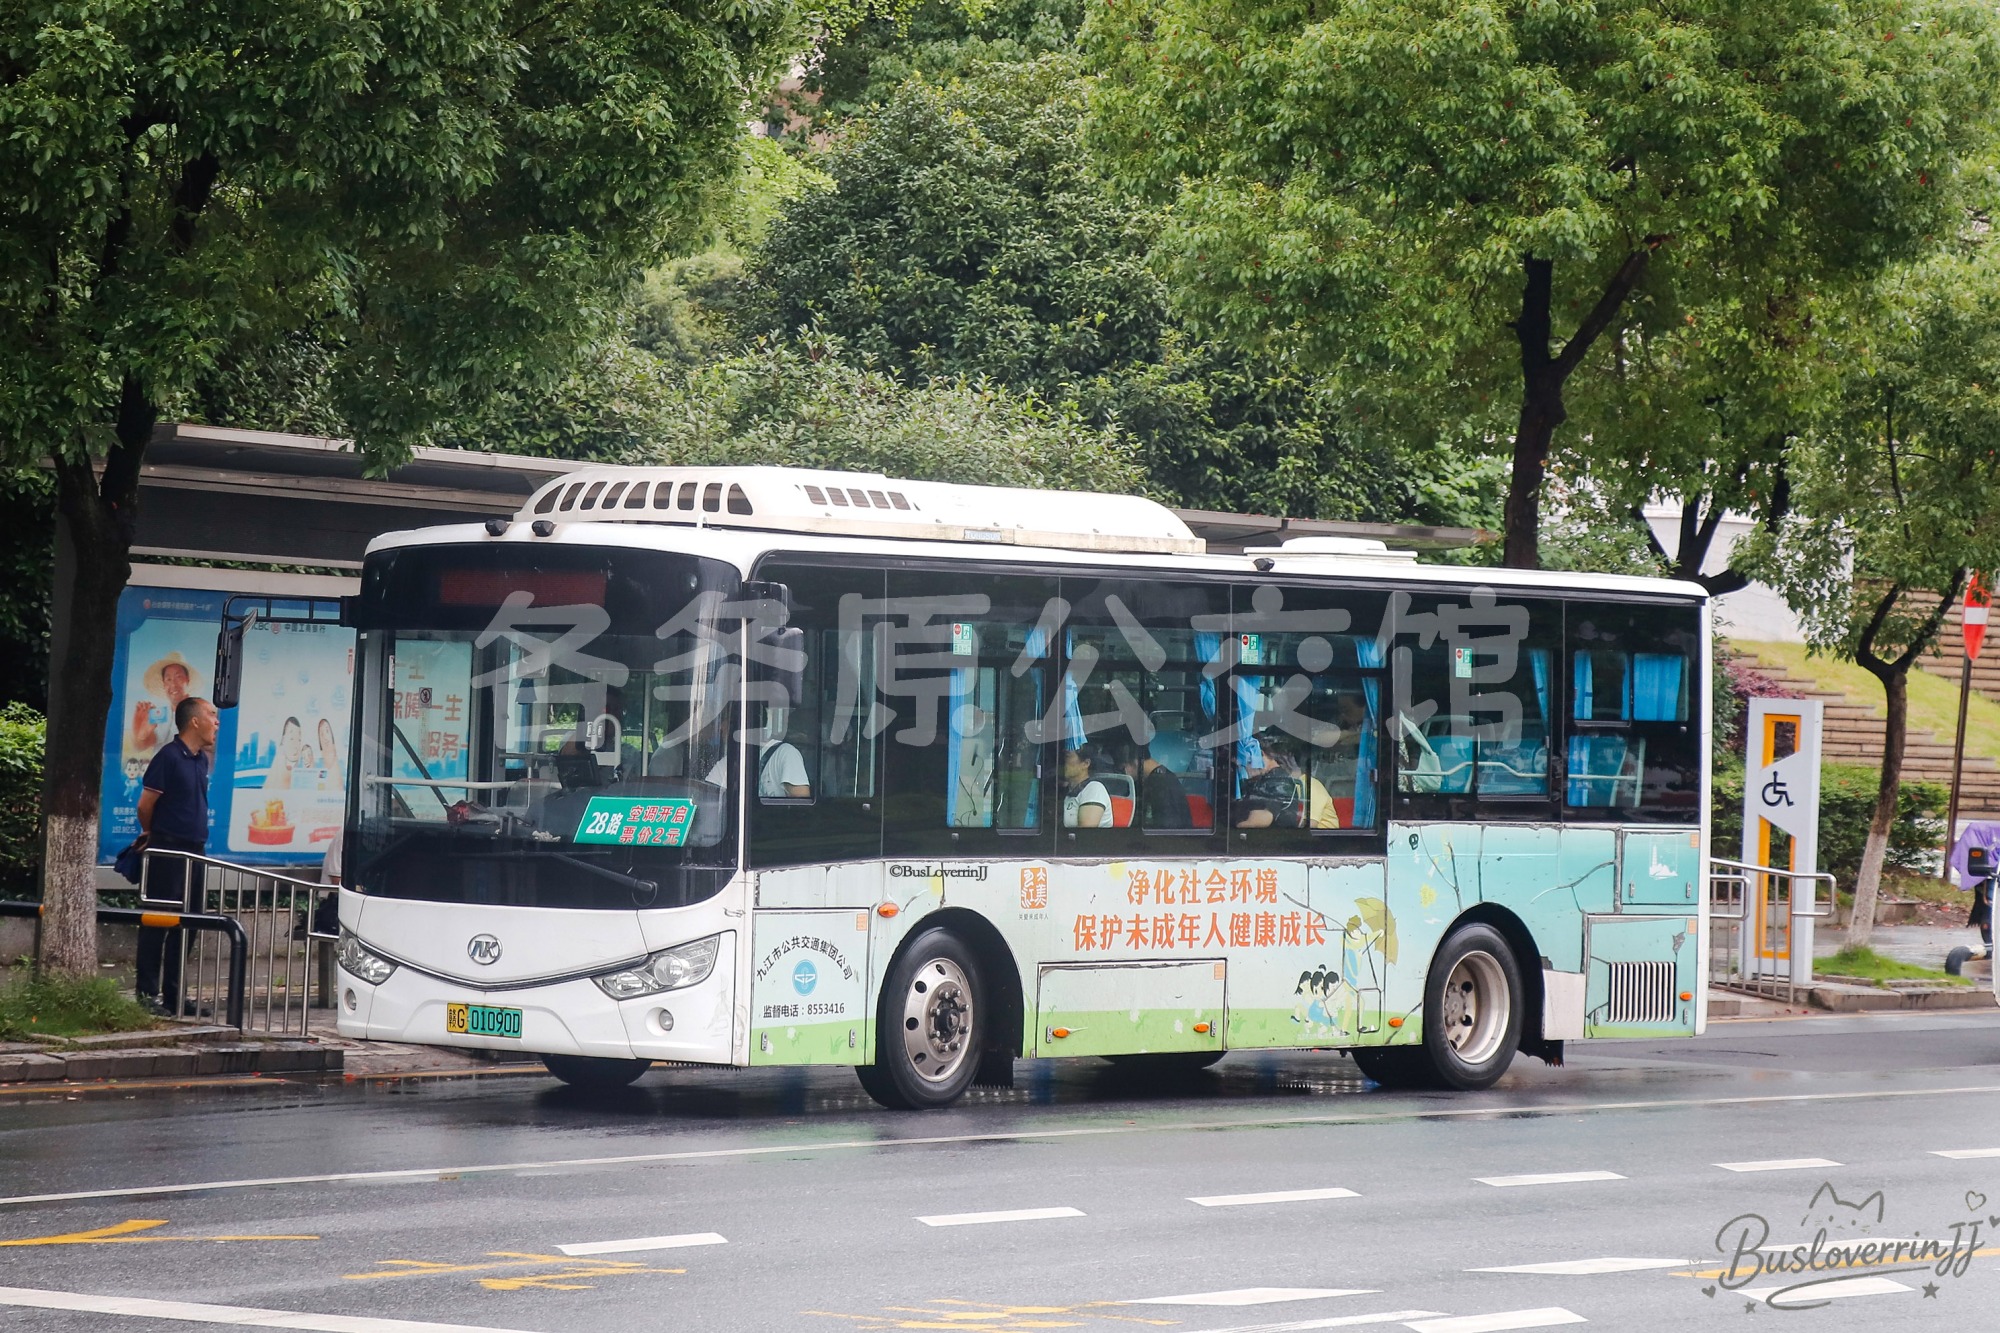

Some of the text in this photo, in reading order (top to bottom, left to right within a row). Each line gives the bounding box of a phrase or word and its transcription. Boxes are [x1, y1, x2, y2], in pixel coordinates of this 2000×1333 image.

[585, 811, 624, 835] 28路
[627, 805, 687, 823] 空调开启
[618, 826, 681, 845] 票价2元
[1126, 868, 1278, 905] 净化社会环境
[1073, 912, 1326, 951] 保护未成年人健康成长
[757, 936, 853, 981] 九江市公共交通集团公司
